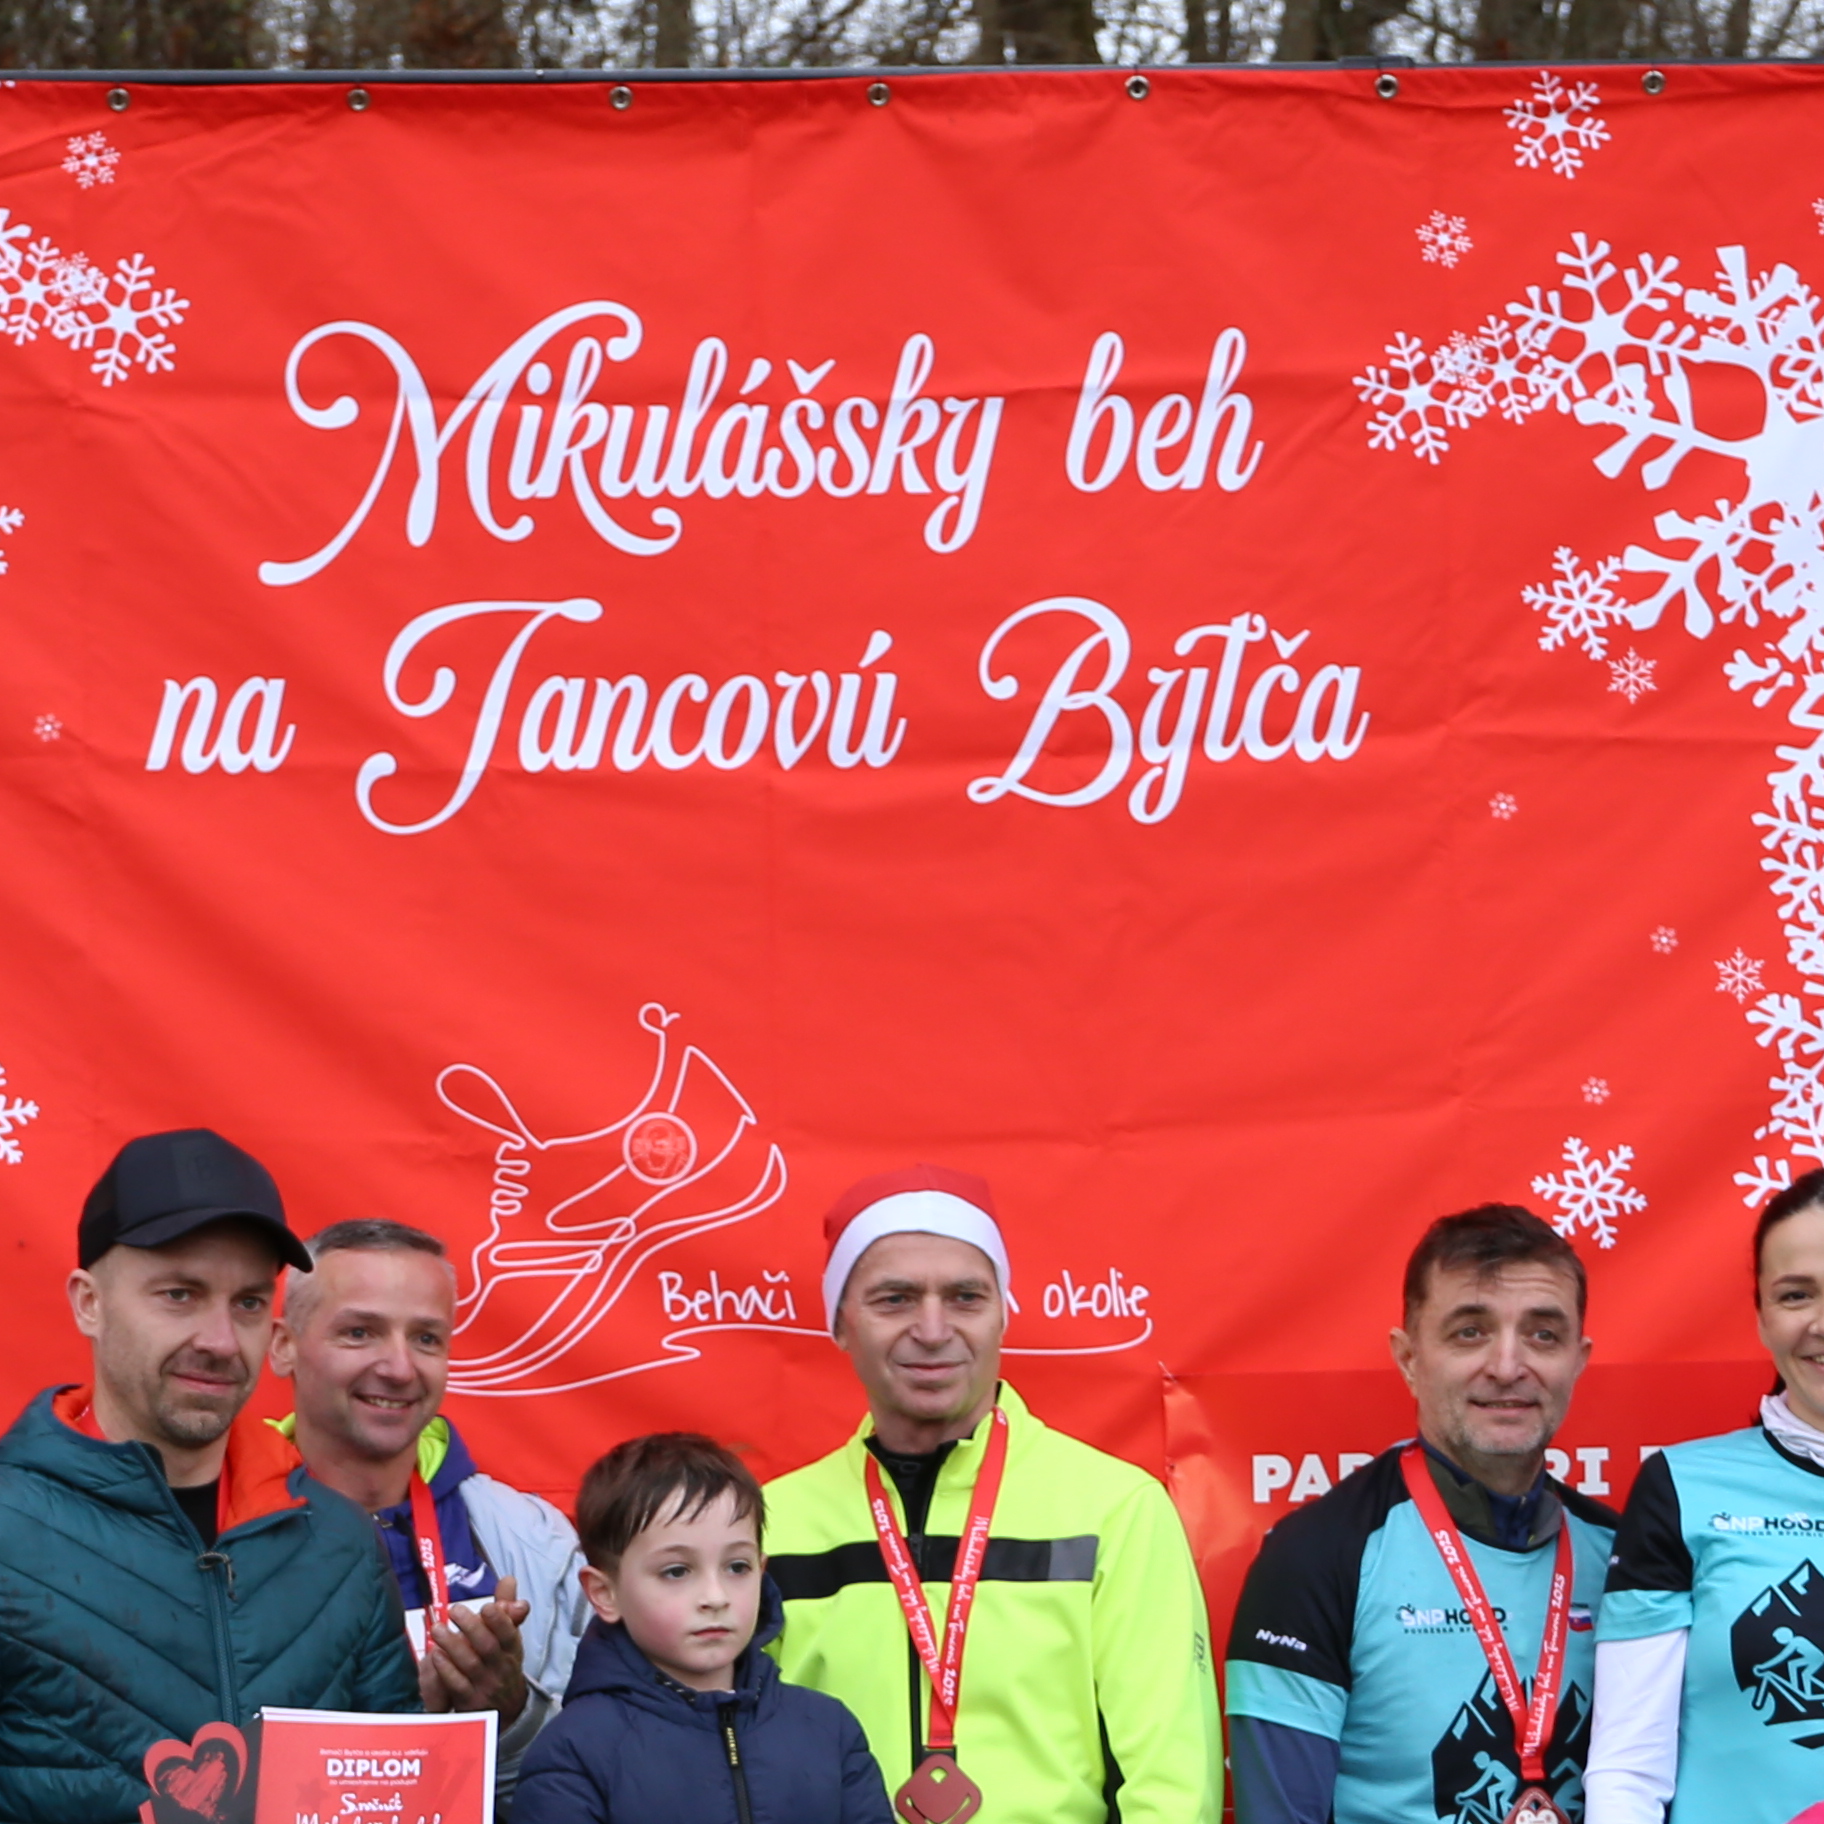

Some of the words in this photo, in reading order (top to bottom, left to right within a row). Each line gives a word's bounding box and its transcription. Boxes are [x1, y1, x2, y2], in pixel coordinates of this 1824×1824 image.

[258, 300, 1004, 586] Mikulášsky
[1065, 326, 1263, 493] beh
[145, 674, 295, 774] na
[355, 597, 906, 835] Tancovú
[967, 595, 1371, 825] Bytča
[658, 1270, 796, 1321] Behači
[1042, 1267, 1150, 1318] okolie
[1435, 1529, 1460, 1565] 2025
[1551, 1574, 1566, 1608] 2025
[1400, 1607, 1507, 1627] SNPHOD
[1255, 1629, 1307, 1651] NyNa
[326, 1758, 421, 1777] DIPLOM
